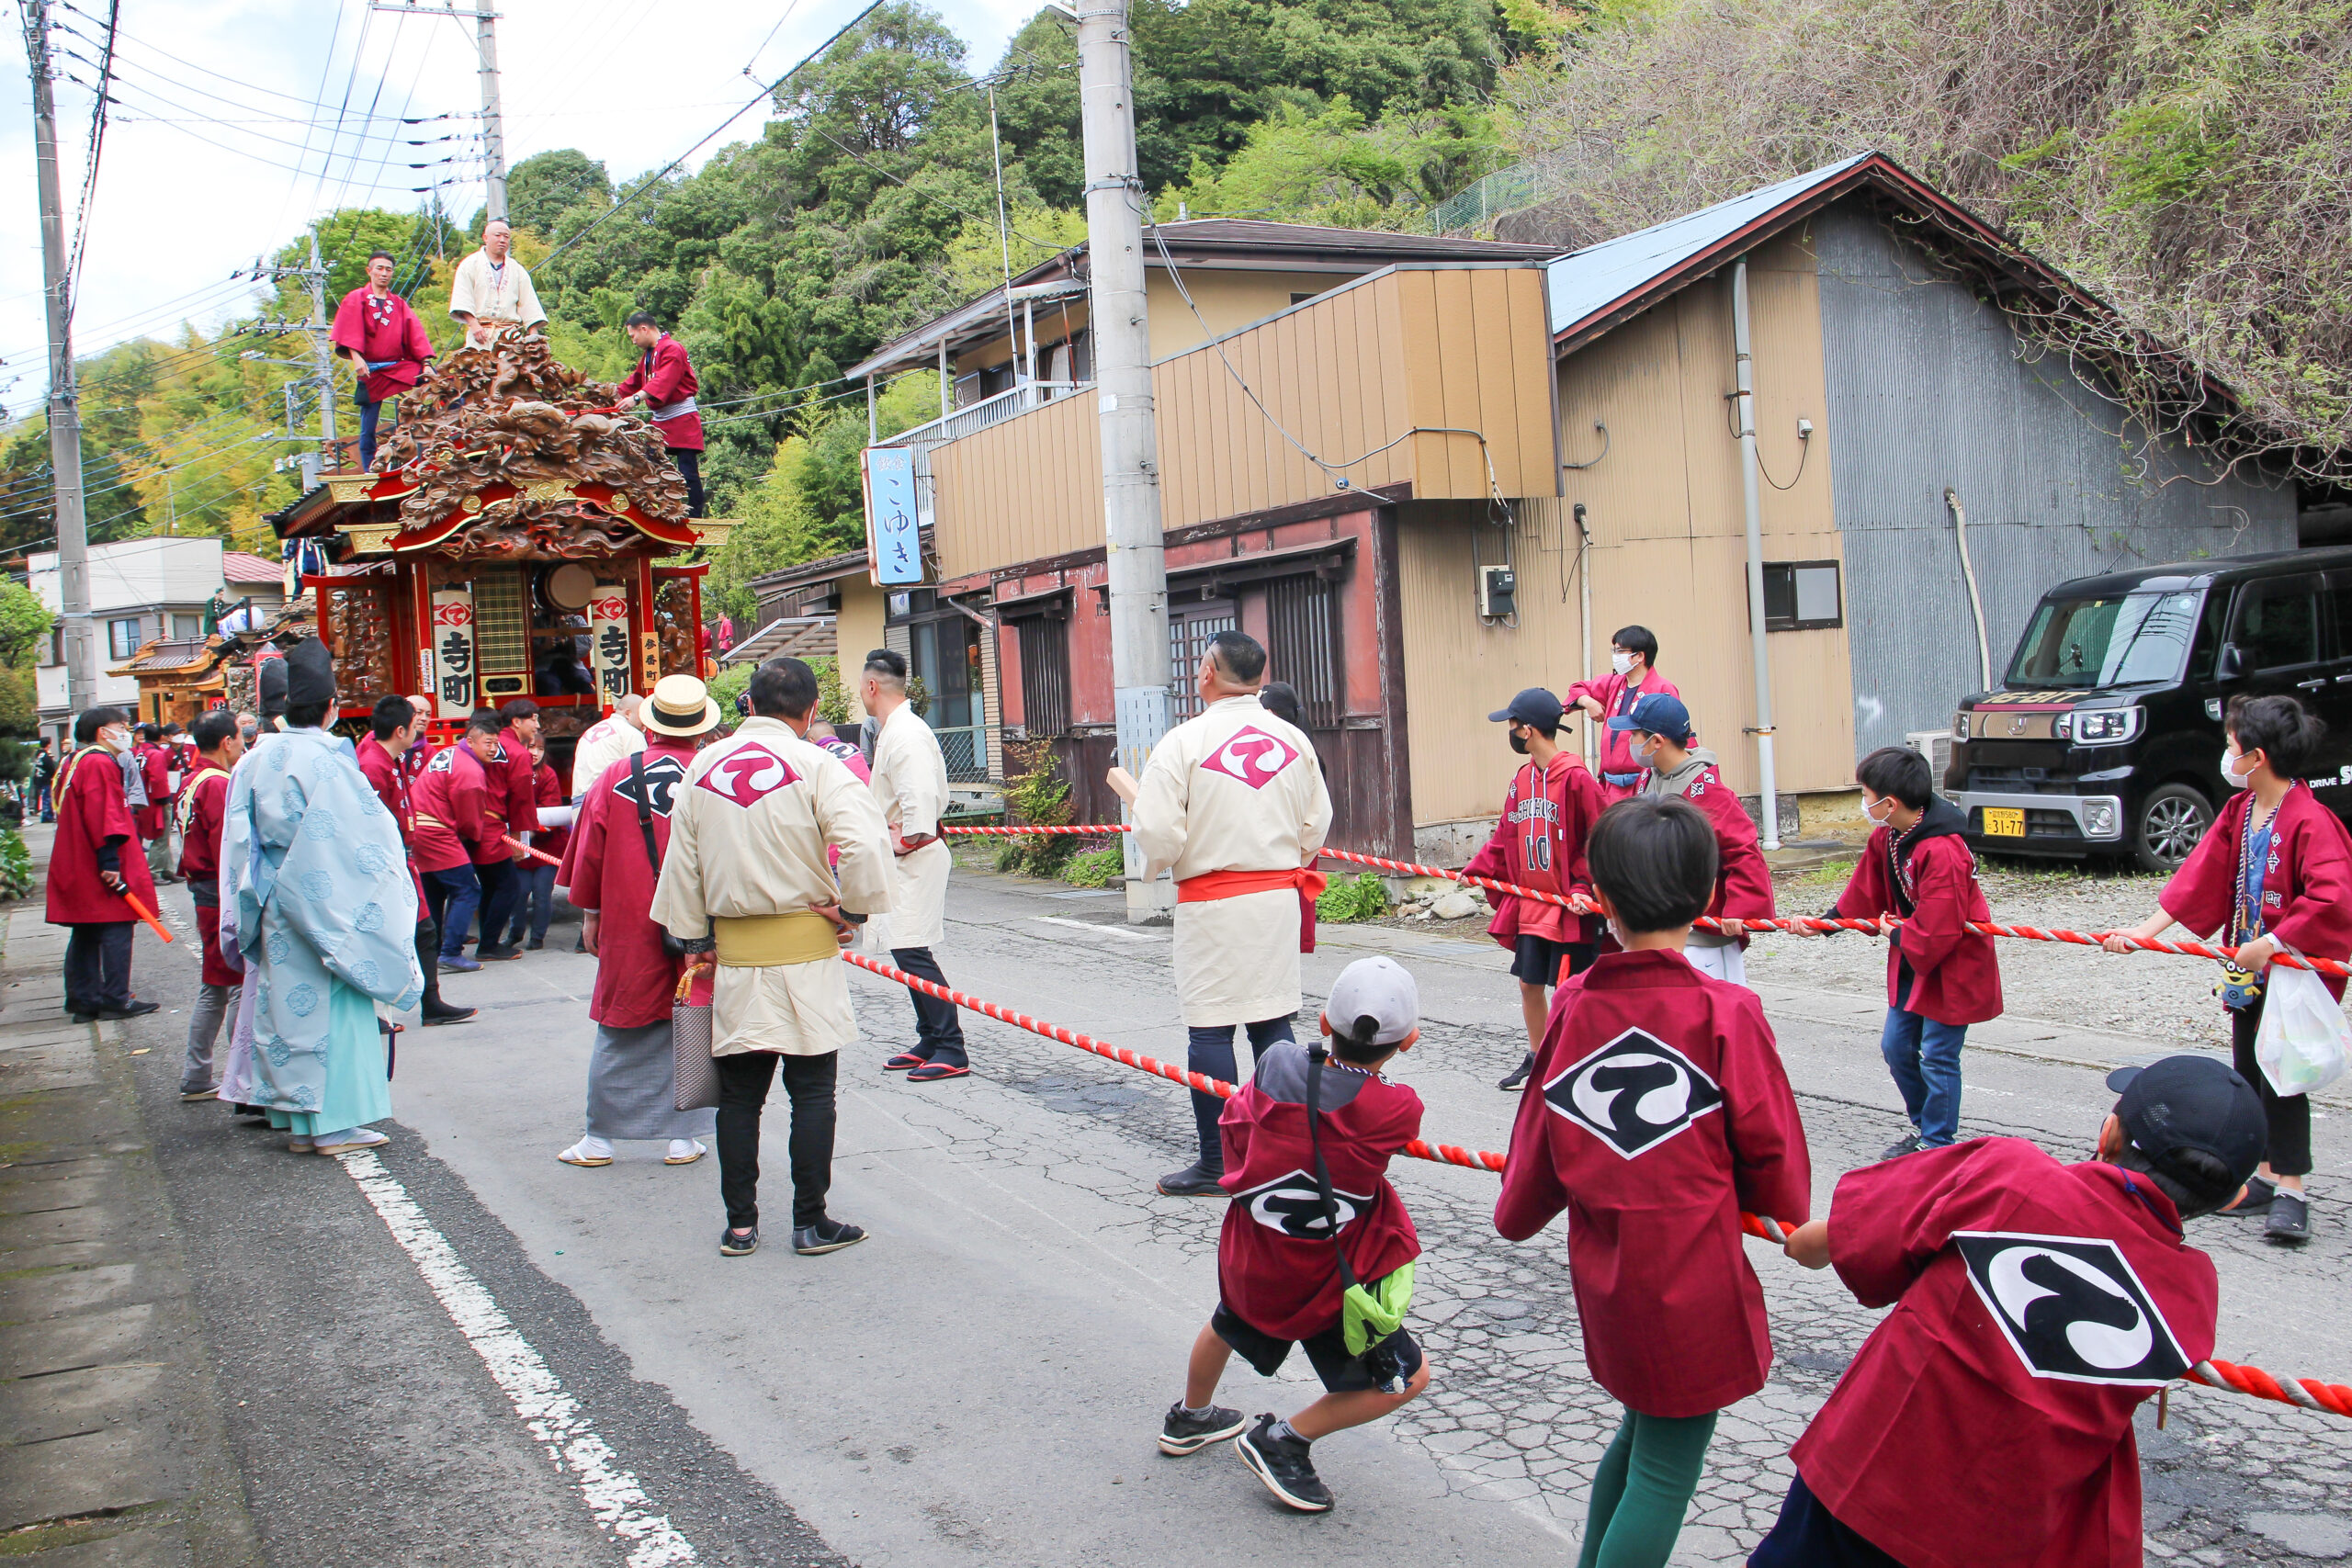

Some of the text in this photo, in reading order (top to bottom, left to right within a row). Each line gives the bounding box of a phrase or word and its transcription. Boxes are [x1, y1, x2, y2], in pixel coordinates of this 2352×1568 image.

[884, 479, 910, 573] こゆき
[441, 631, 472, 707] 寺町
[600, 626, 630, 699] 寺町
[2310, 765, 2352, 789] DRIVE S
[1525, 835, 1551, 871] 10
[1993, 820, 2023, 835] 31-77
